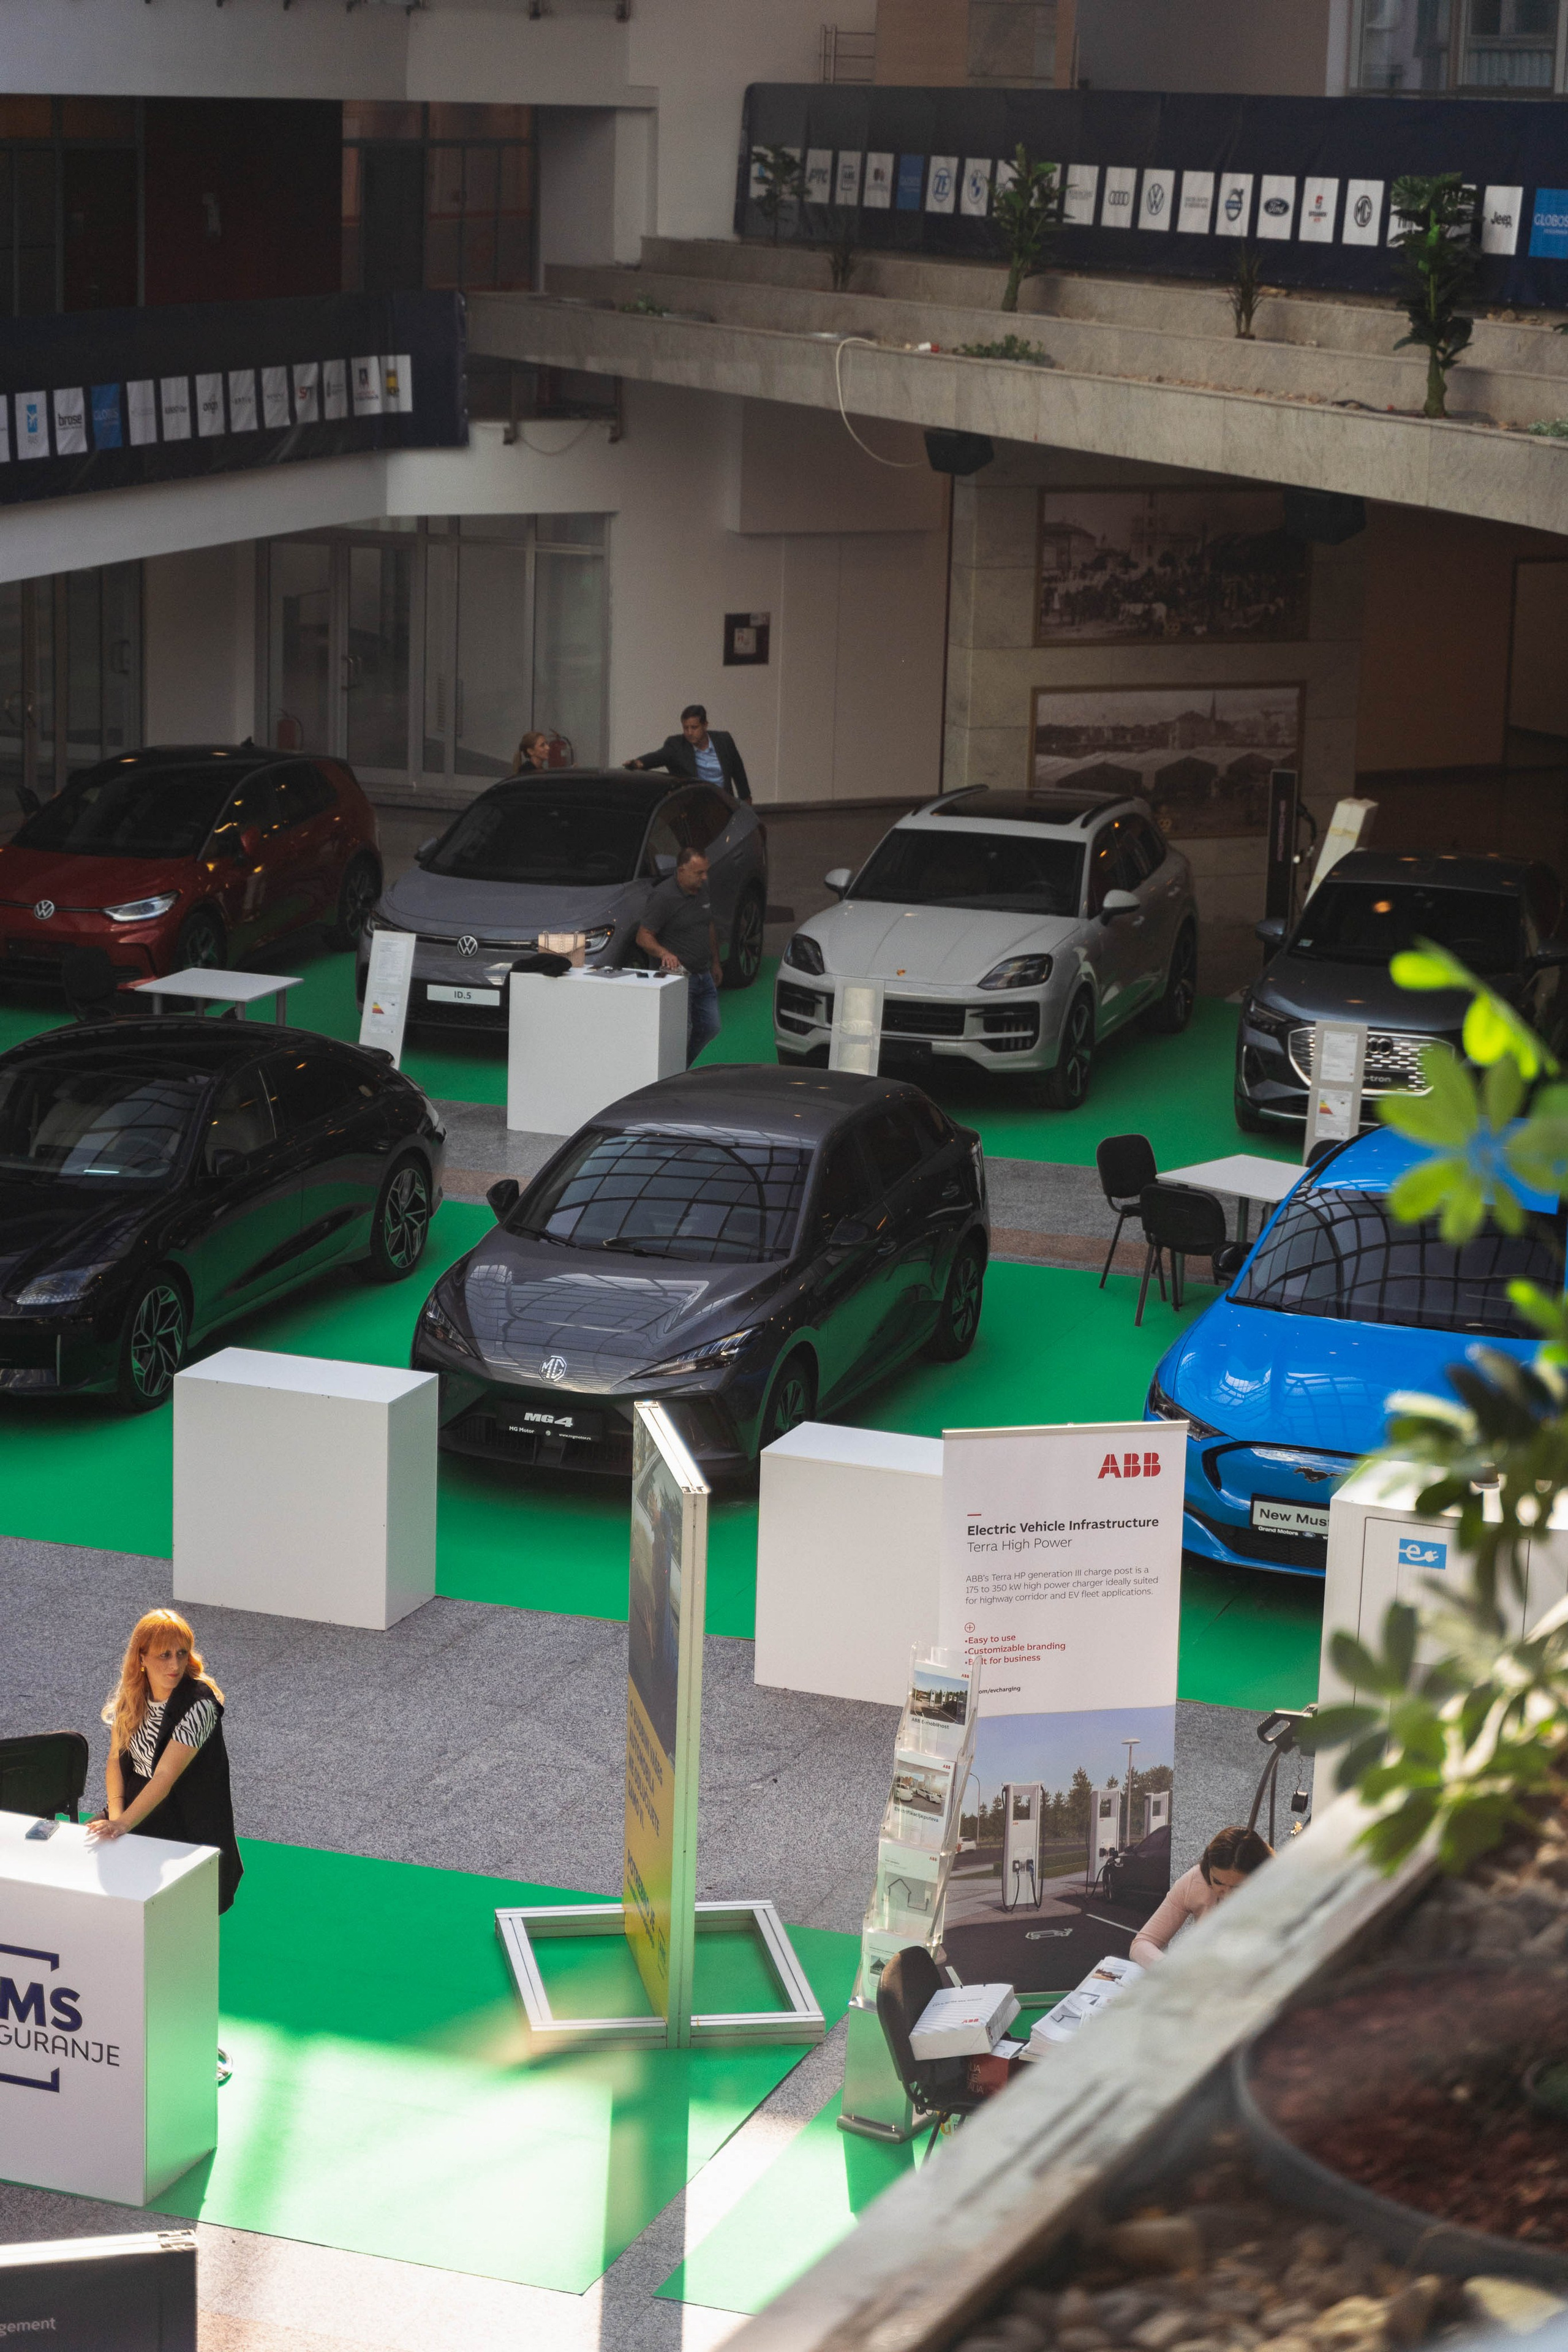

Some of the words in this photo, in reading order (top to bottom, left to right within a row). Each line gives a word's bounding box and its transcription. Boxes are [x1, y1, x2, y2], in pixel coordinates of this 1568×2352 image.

[1266, 200, 1286, 214] Ford
[1355, 197, 1372, 226] MG
[1491, 211, 1512, 228] Jeep
[58, 413, 82, 427] brose
[454, 990, 471, 1000] ID.5
[540, 1357, 567, 1381] MG
[1098, 1452, 1161, 1479] ABB
[1260, 1508, 1292, 1521] New
[1296, 1513, 1330, 1527] Mus
[967, 1523, 1016, 1536] Electric
[1020, 1520, 1065, 1533] Vehicle
[1069, 1517, 1159, 1531] Infrastructure
[967, 1542, 998, 1553] Terra
[1002, 1538, 1030, 1553] High
[1035, 1537, 1072, 1549] Power
[965, 1574, 989, 1583] ABB's
[1028, 1570, 1072, 1580] generation
[1084, 1568, 1112, 1577] charge
[1114, 1567, 1133, 1576] post
[992, 1584, 1007, 1593] 350
[1009, 1582, 1022, 1591] kW
[1023, 1581, 1041, 1591] high
[1044, 1581, 1070, 1590] power
[1072, 1580, 1103, 1588] charger
[1106, 1577, 1131, 1586] ideally
[1133, 1576, 1158, 1585] suited
[980, 1596, 1014, 1605] highway
[1015, 1593, 1048, 1602] corridor
[1101, 1588, 1153, 1598] applications.
[1027, 1642, 1066, 1651] branding
[1004, 1654, 1041, 1663] business
